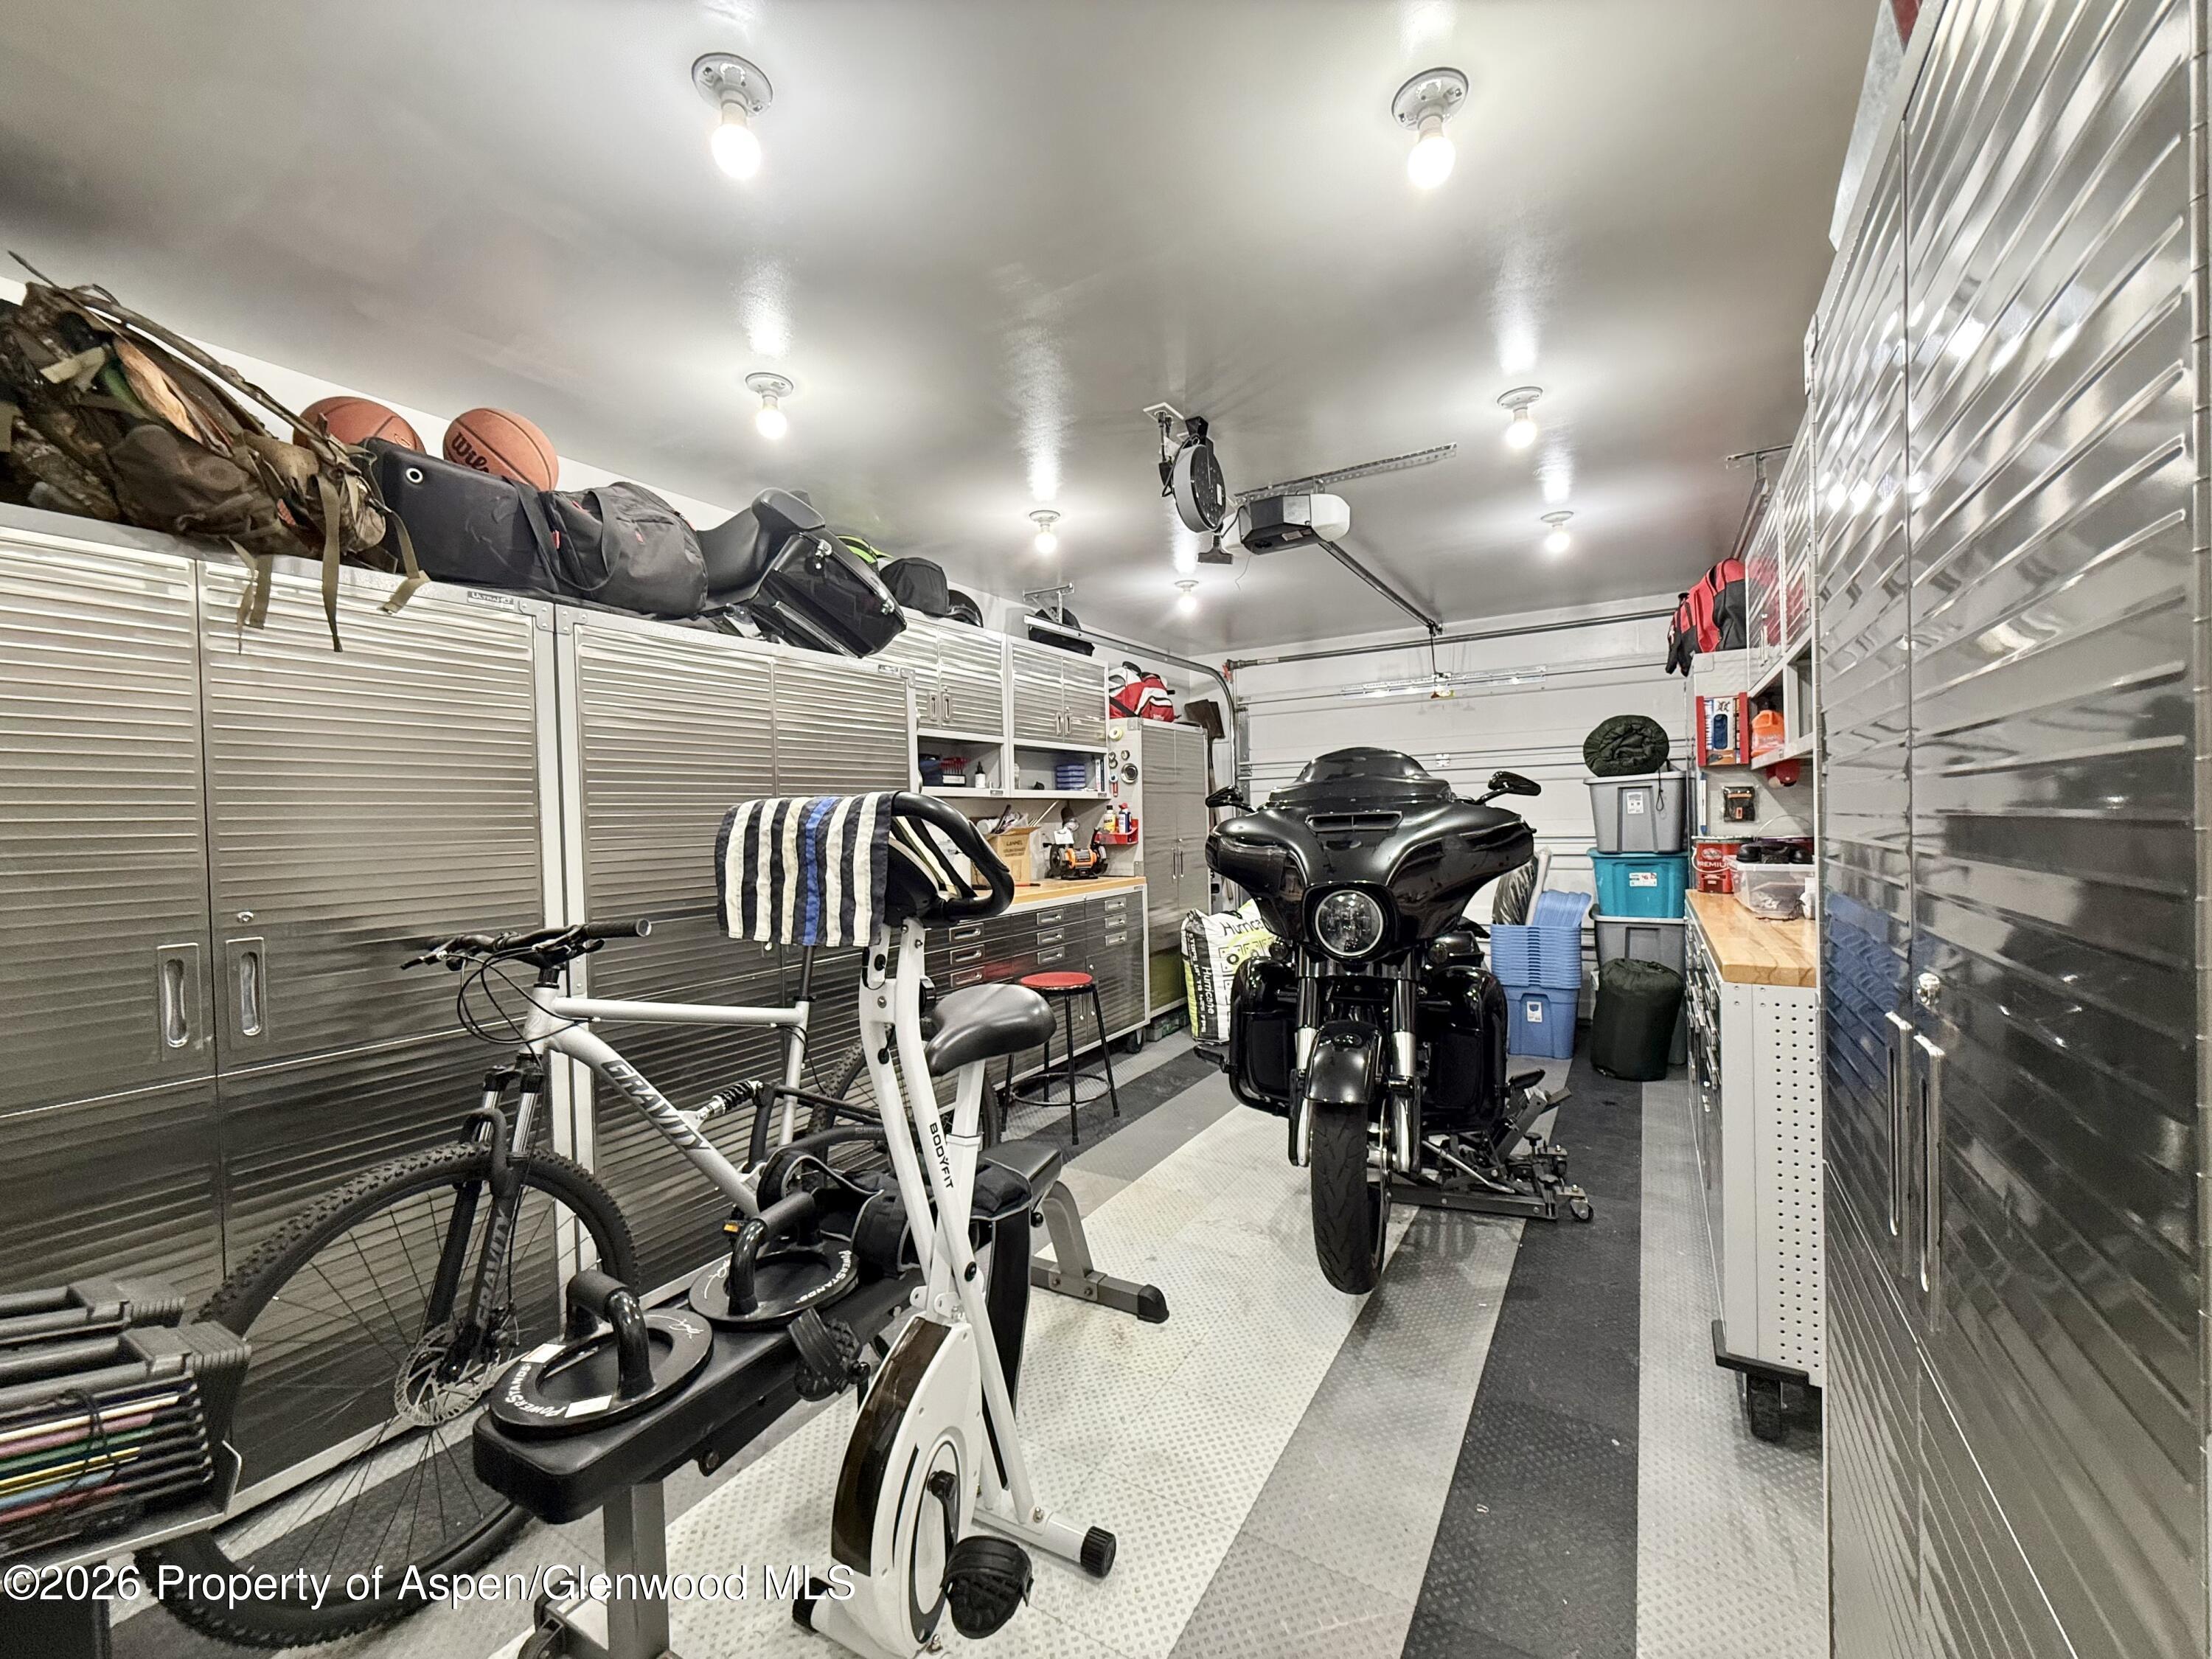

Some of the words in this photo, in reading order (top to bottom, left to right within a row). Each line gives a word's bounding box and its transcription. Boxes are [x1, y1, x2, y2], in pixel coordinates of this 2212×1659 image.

[451, 431, 490, 473] Wil
[1220, 919, 1264, 936] Hurrica
[1202, 966, 1214, 1015] Hurricane
[601, 1060, 712, 1150] GRAVITY
[929, 1121, 954, 1189] BODYFIT
